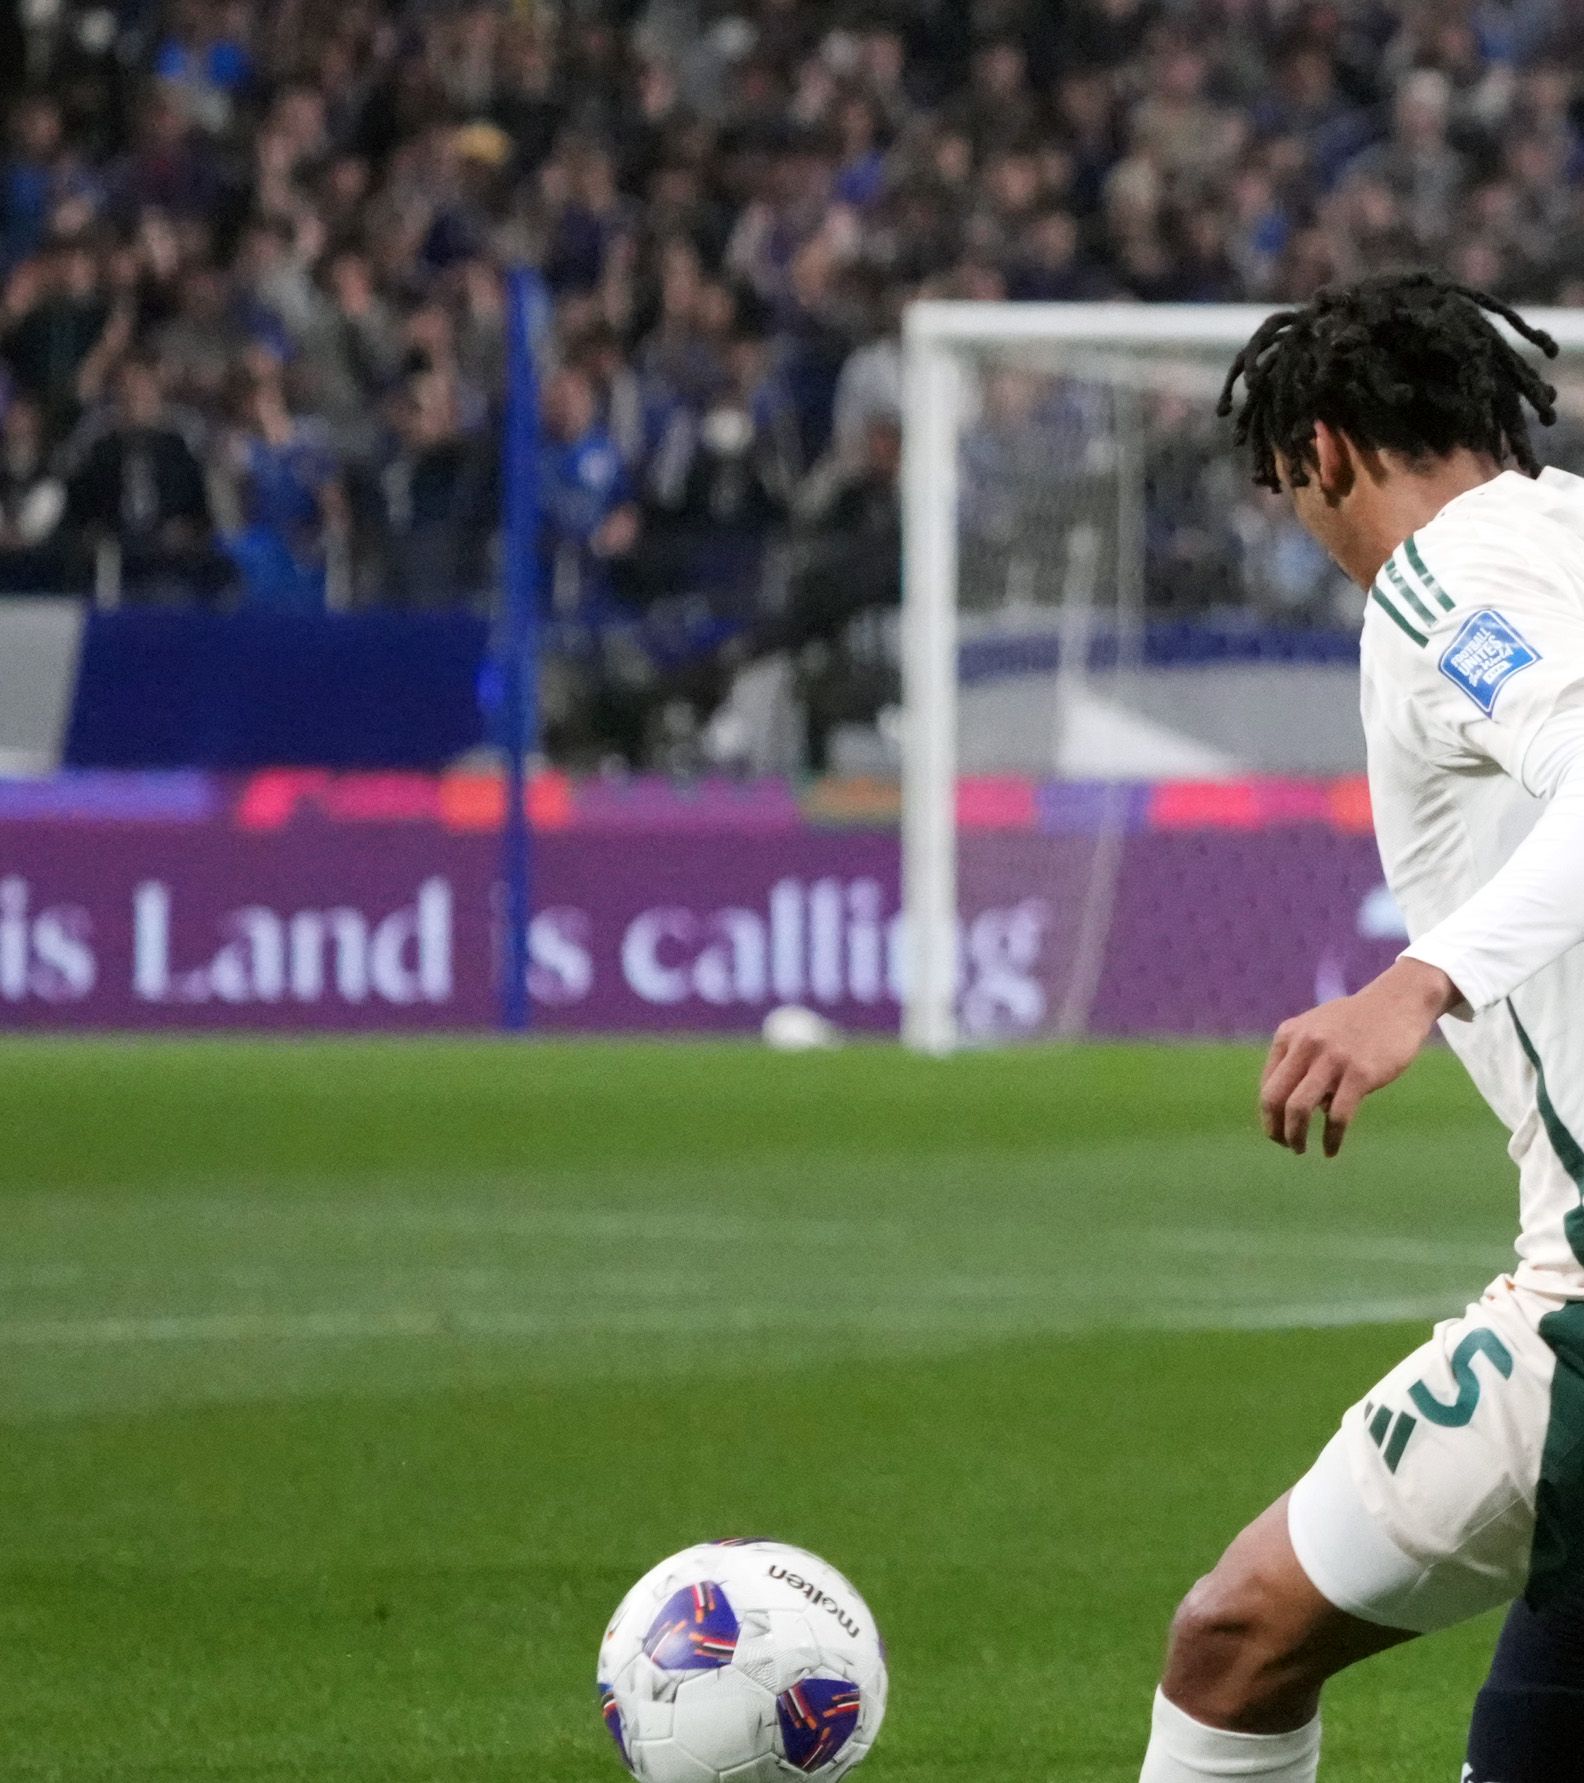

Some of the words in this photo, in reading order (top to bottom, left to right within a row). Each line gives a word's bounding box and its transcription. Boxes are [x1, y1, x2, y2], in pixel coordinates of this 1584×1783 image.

[1458, 635, 1503, 676] UNITES
[132, 872, 454, 1003] Land
[768, 1564, 860, 1638] molten
